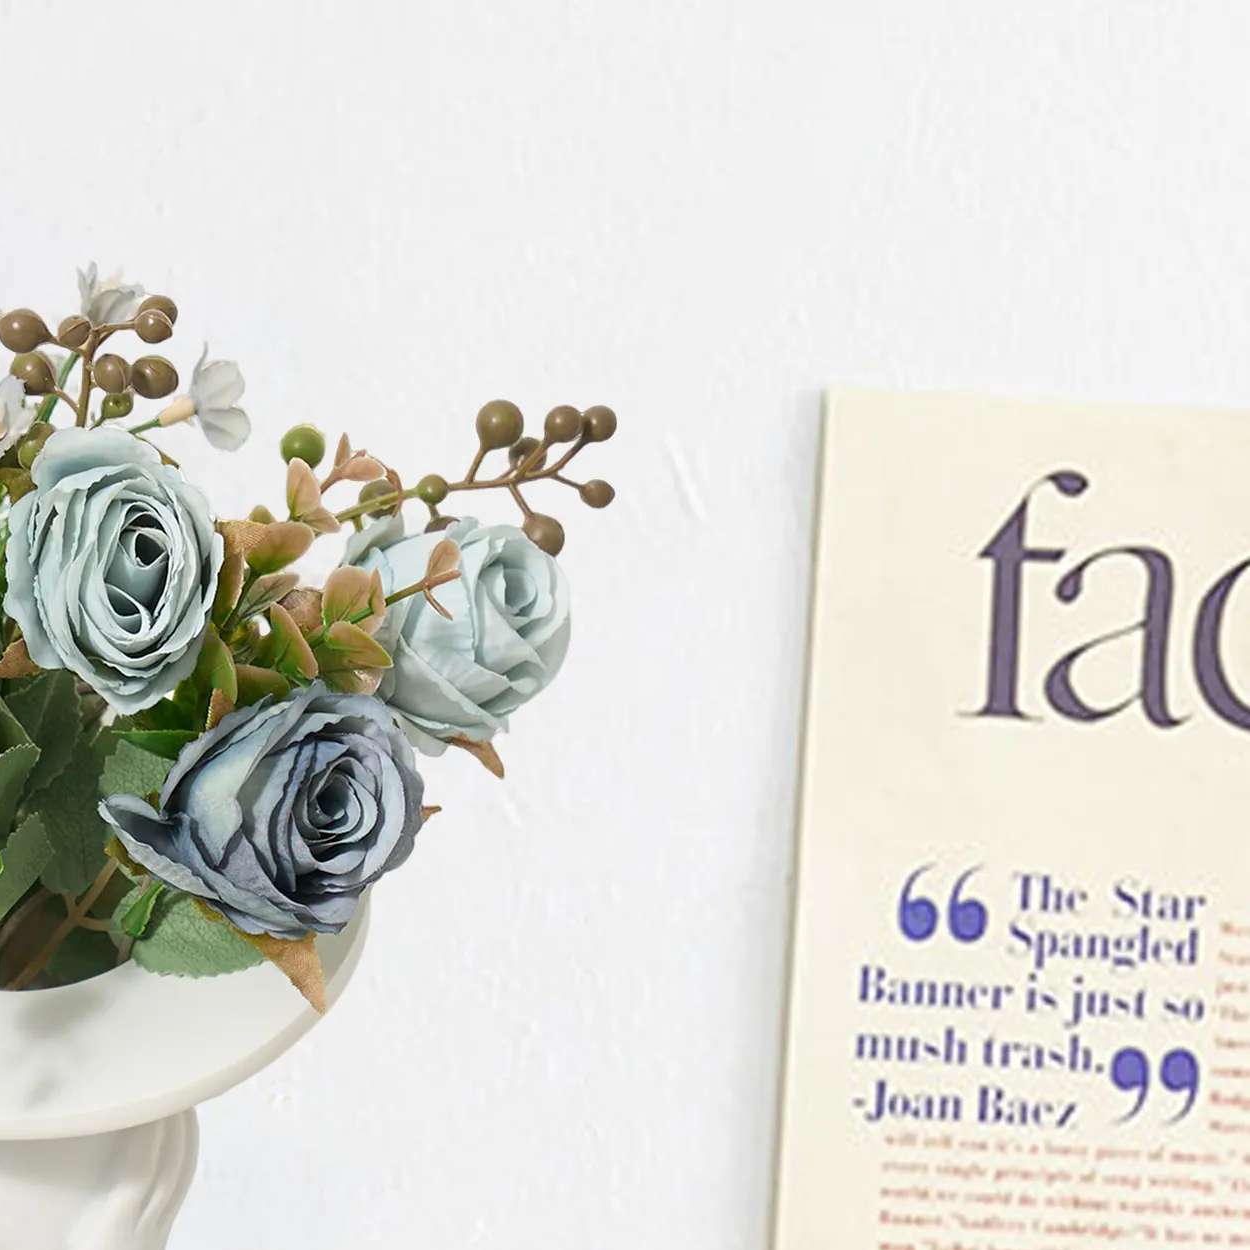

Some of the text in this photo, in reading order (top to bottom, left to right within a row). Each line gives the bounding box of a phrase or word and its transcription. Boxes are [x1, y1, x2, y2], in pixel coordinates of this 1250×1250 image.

[1012, 874, 1206, 920] The Star
[1008, 922, 1200, 970] Spangled
[858, 965, 1205, 1029] Banner is just so
[855, 1026, 1104, 1075] mush trash.
[976, 1084, 1078, 1129] Baez
